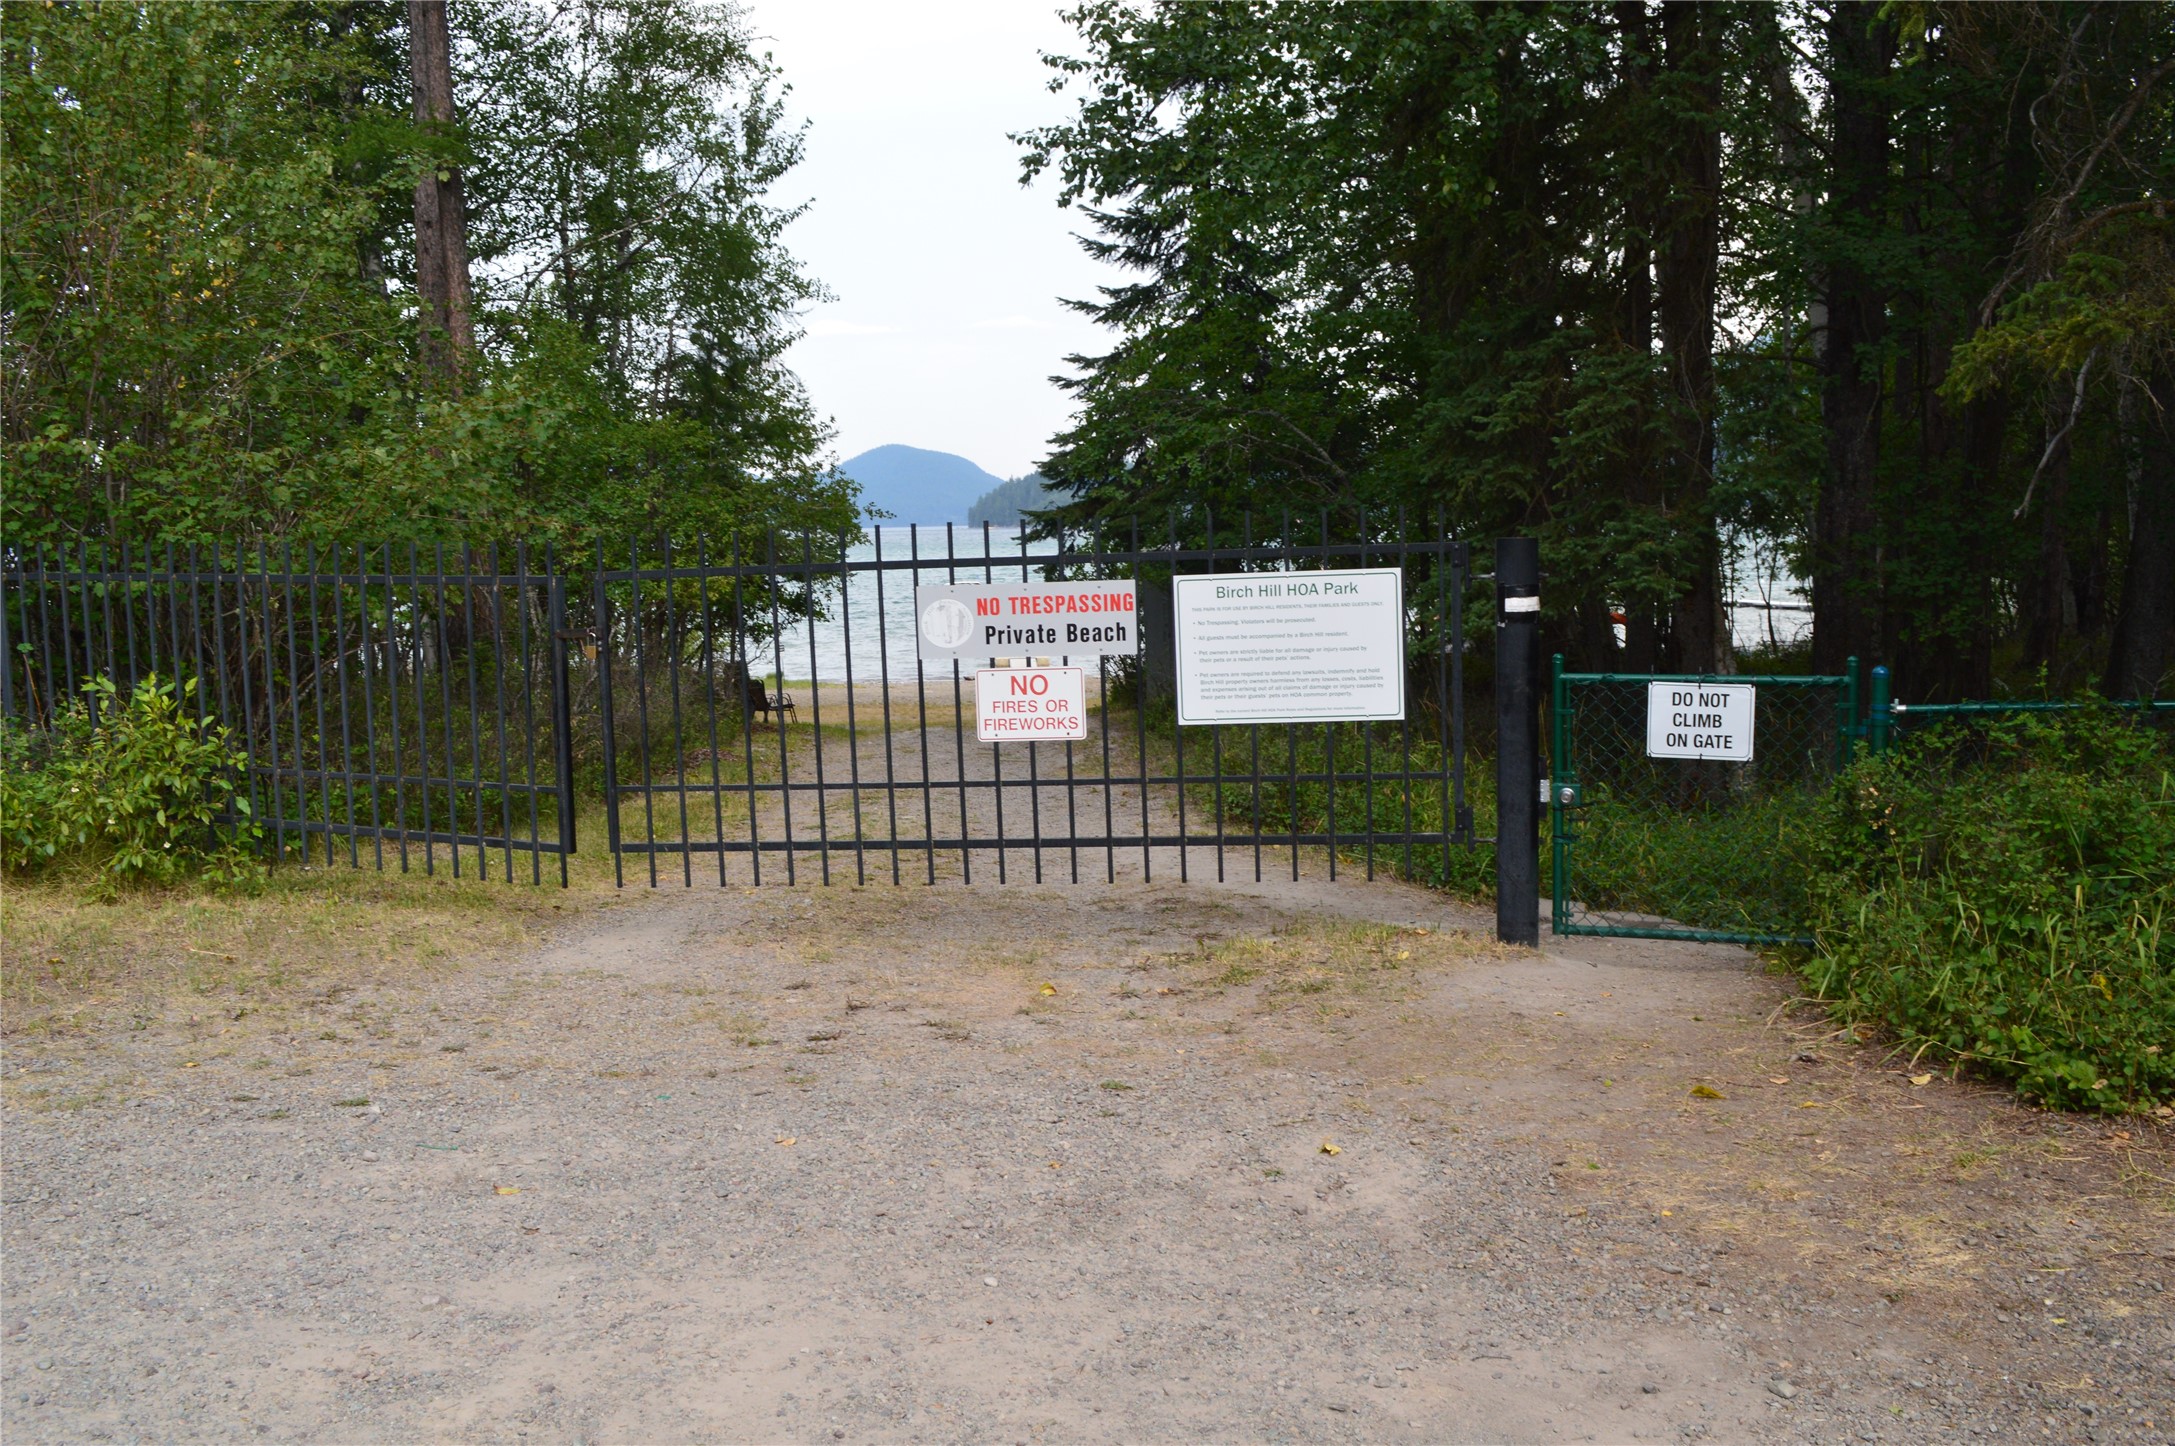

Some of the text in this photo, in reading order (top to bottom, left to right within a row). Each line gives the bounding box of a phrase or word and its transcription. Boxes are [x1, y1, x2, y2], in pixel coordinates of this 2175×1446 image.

[1216, 581, 1358, 599] Birch Hill HOA Park
[977, 593, 1134, 615] NO TRESPASSING
[985, 622, 1126, 644] Private Beach
[1010, 675, 1049, 695] NO
[993, 699, 1069, 713] FIRES OR
[1672, 692, 1730, 708] DO NOT
[984, 716, 1079, 731] FIREWORKS
[1672, 713, 1722, 728] CLIMB
[1666, 733, 1733, 749] ON GATE
